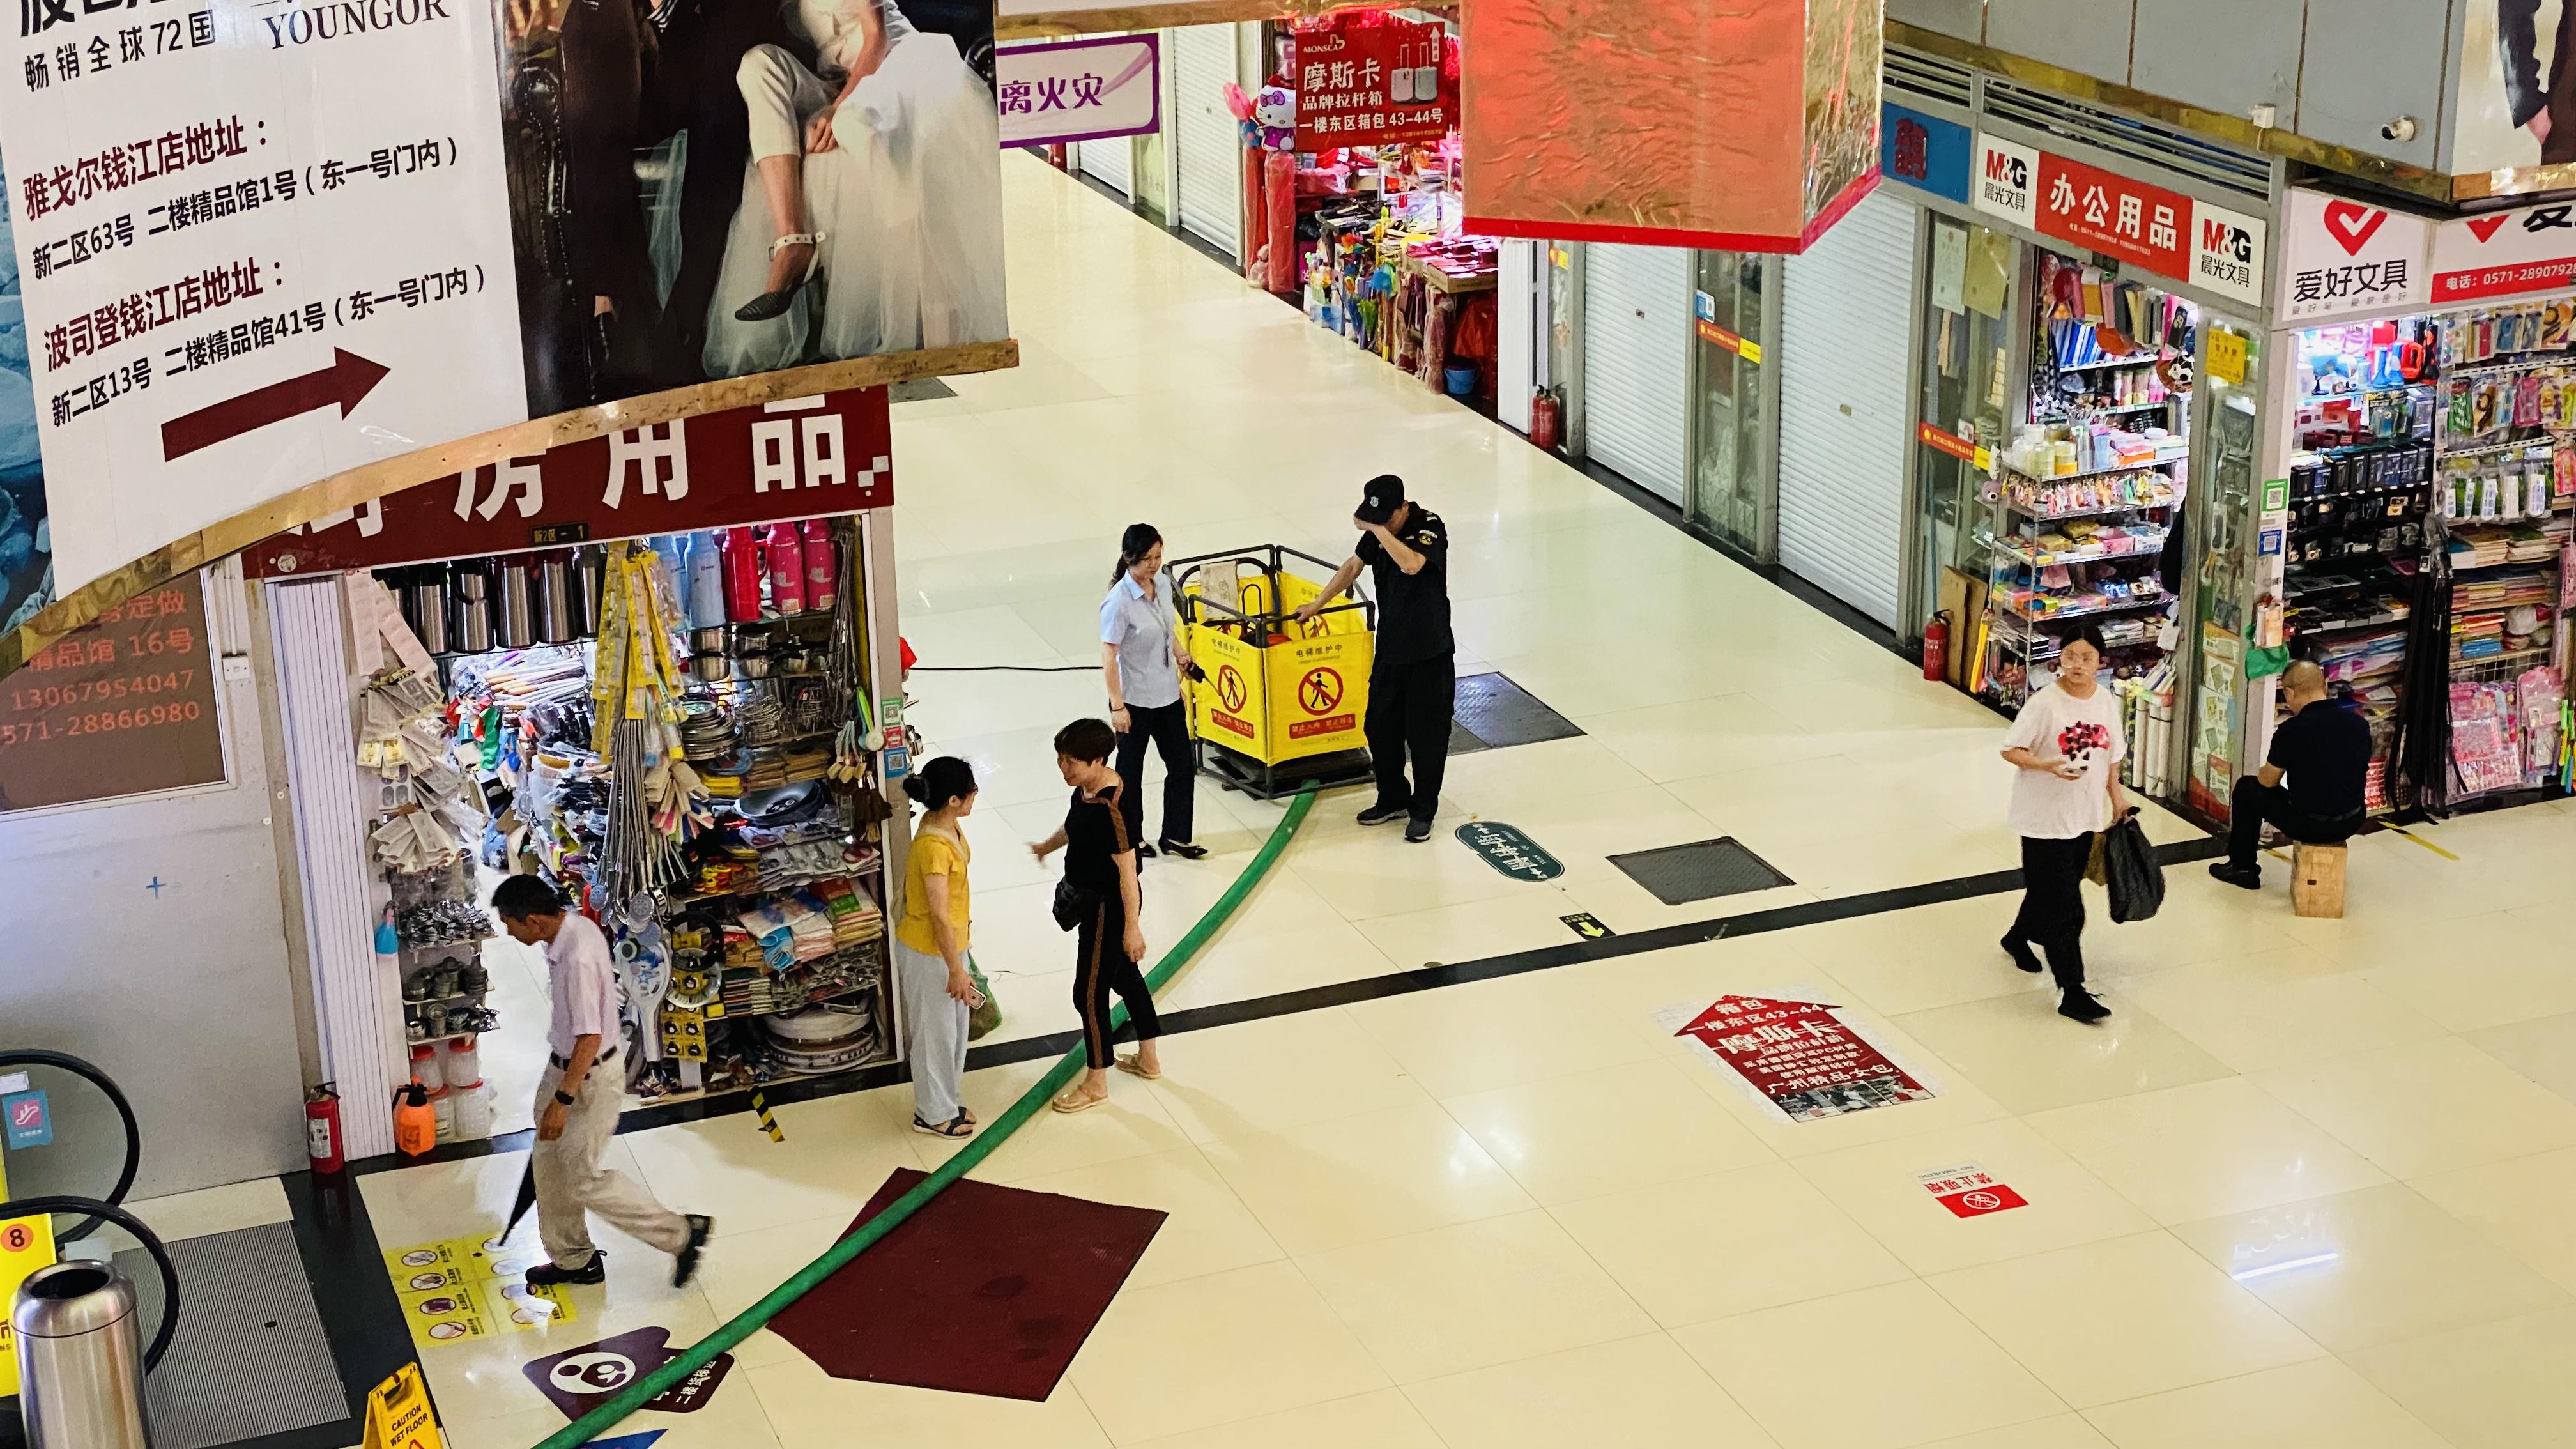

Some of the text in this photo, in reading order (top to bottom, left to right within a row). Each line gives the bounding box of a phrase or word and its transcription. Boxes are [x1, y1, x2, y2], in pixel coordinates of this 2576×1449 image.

[262, 0, 450, 49] YOUNGOR
[24, 9, 216, 93] 畅销全球72国
[1303, 58, 1380, 93] 摩斯卡
[1303, 90, 1383, 111] 品牌拉杆箱
[1300, 107, 1443, 133] 一楼东区箱包 43-44号
[1986, 149, 2027, 190] M&G
[1984, 183, 2026, 212] 晨光文具
[2050, 174, 2177, 251] 办公用品
[33, 215, 134, 280] 新二区63号
[2203, 218, 2251, 264] M&G
[2201, 255, 2250, 289] 晨光文具
[2294, 259, 2407, 303] 爱好文具
[52, 357, 153, 427] 新二区13号
[288, 393, 845, 537] 房用品
[128, 627, 195, 657] 16号
[1296, 643, 1343, 658] 电梯维护中
[1715, 999, 1768, 1016] 箱包
[1717, 1020, 1841, 1055] 摩斯卡
[1767, 1064, 1894, 1094] 广州精品女包
[1923, 1172, 1993, 1194] 禁止吸烟
[10, 1227, 25, 1248] 8
[390, 1413, 428, 1447] WET FLOOR
[392, 1404, 422, 1432] CAUTION
